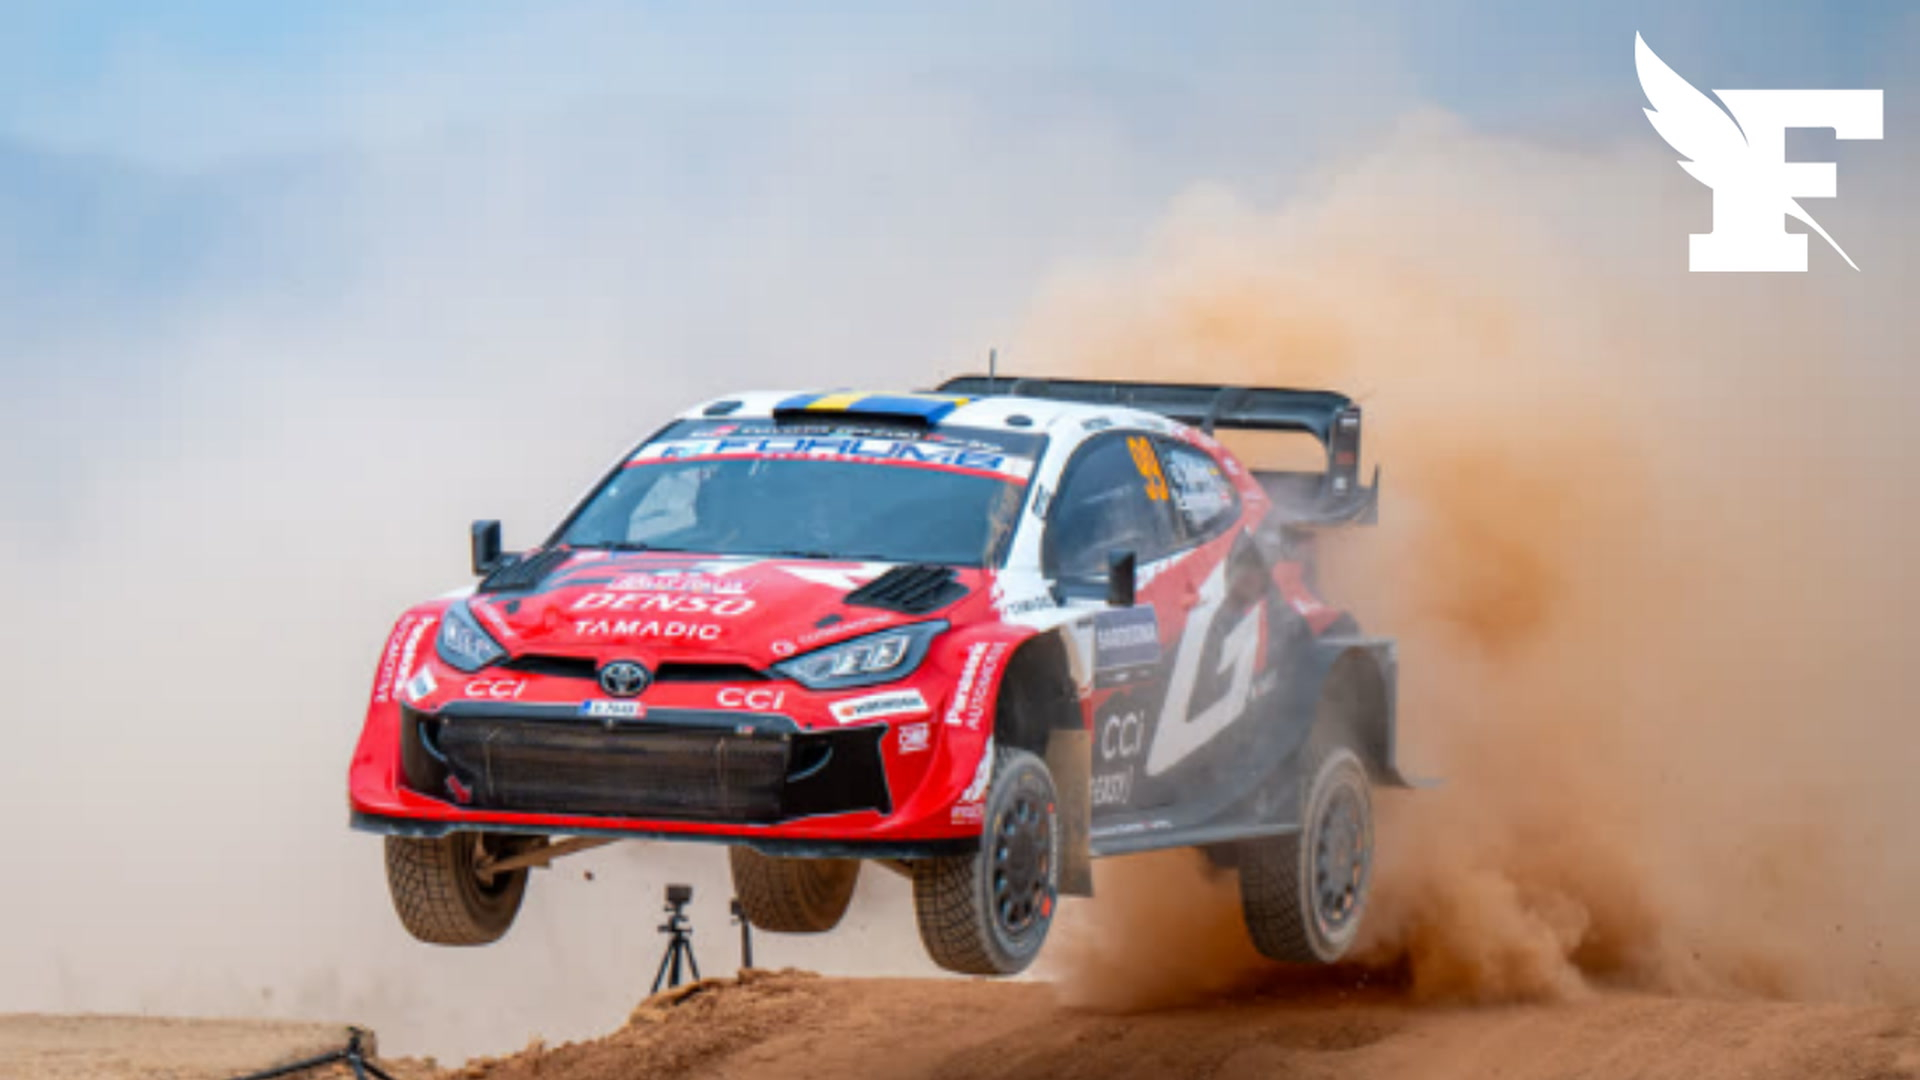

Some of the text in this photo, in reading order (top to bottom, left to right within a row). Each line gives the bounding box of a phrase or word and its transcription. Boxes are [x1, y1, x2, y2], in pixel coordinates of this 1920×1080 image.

[568, 592, 757, 616] DENSO
[574, 620, 722, 641] TAMADIC
[463, 679, 527, 698] CCI
[716, 687, 785, 711] CCI
